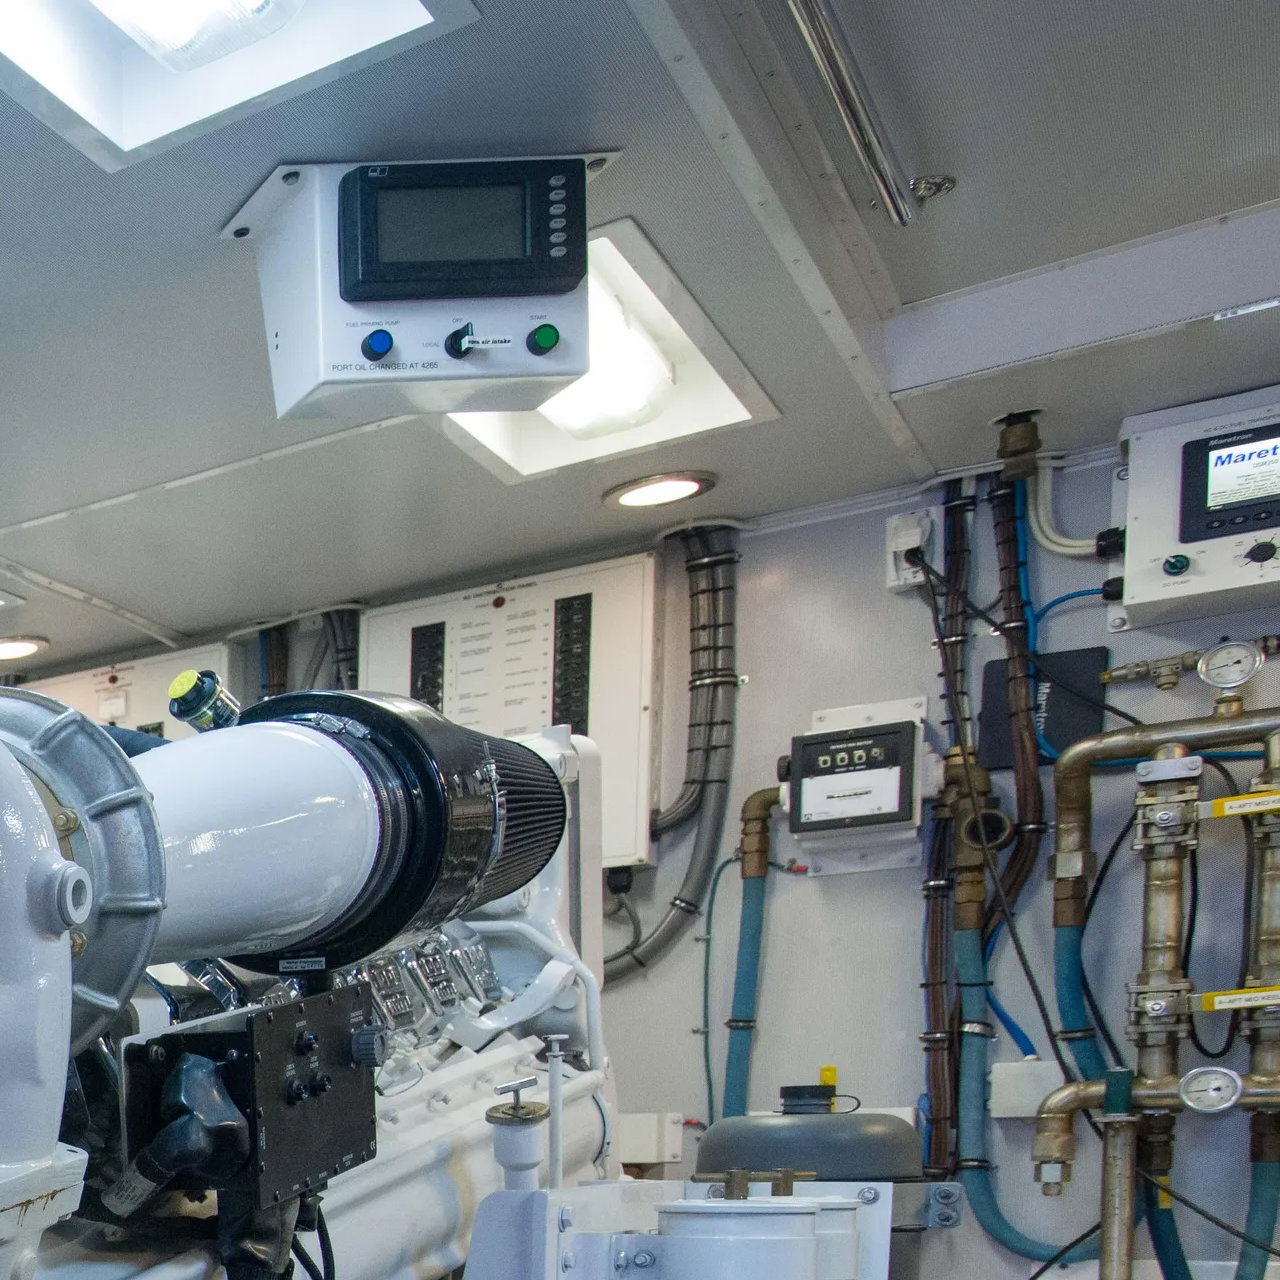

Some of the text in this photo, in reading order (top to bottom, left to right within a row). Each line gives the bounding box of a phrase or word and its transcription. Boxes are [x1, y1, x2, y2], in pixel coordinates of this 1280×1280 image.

[384, 319, 401, 327] PUMP
[369, 363, 407, 371] CHANGED
[421, 361, 439, 369] 4265
